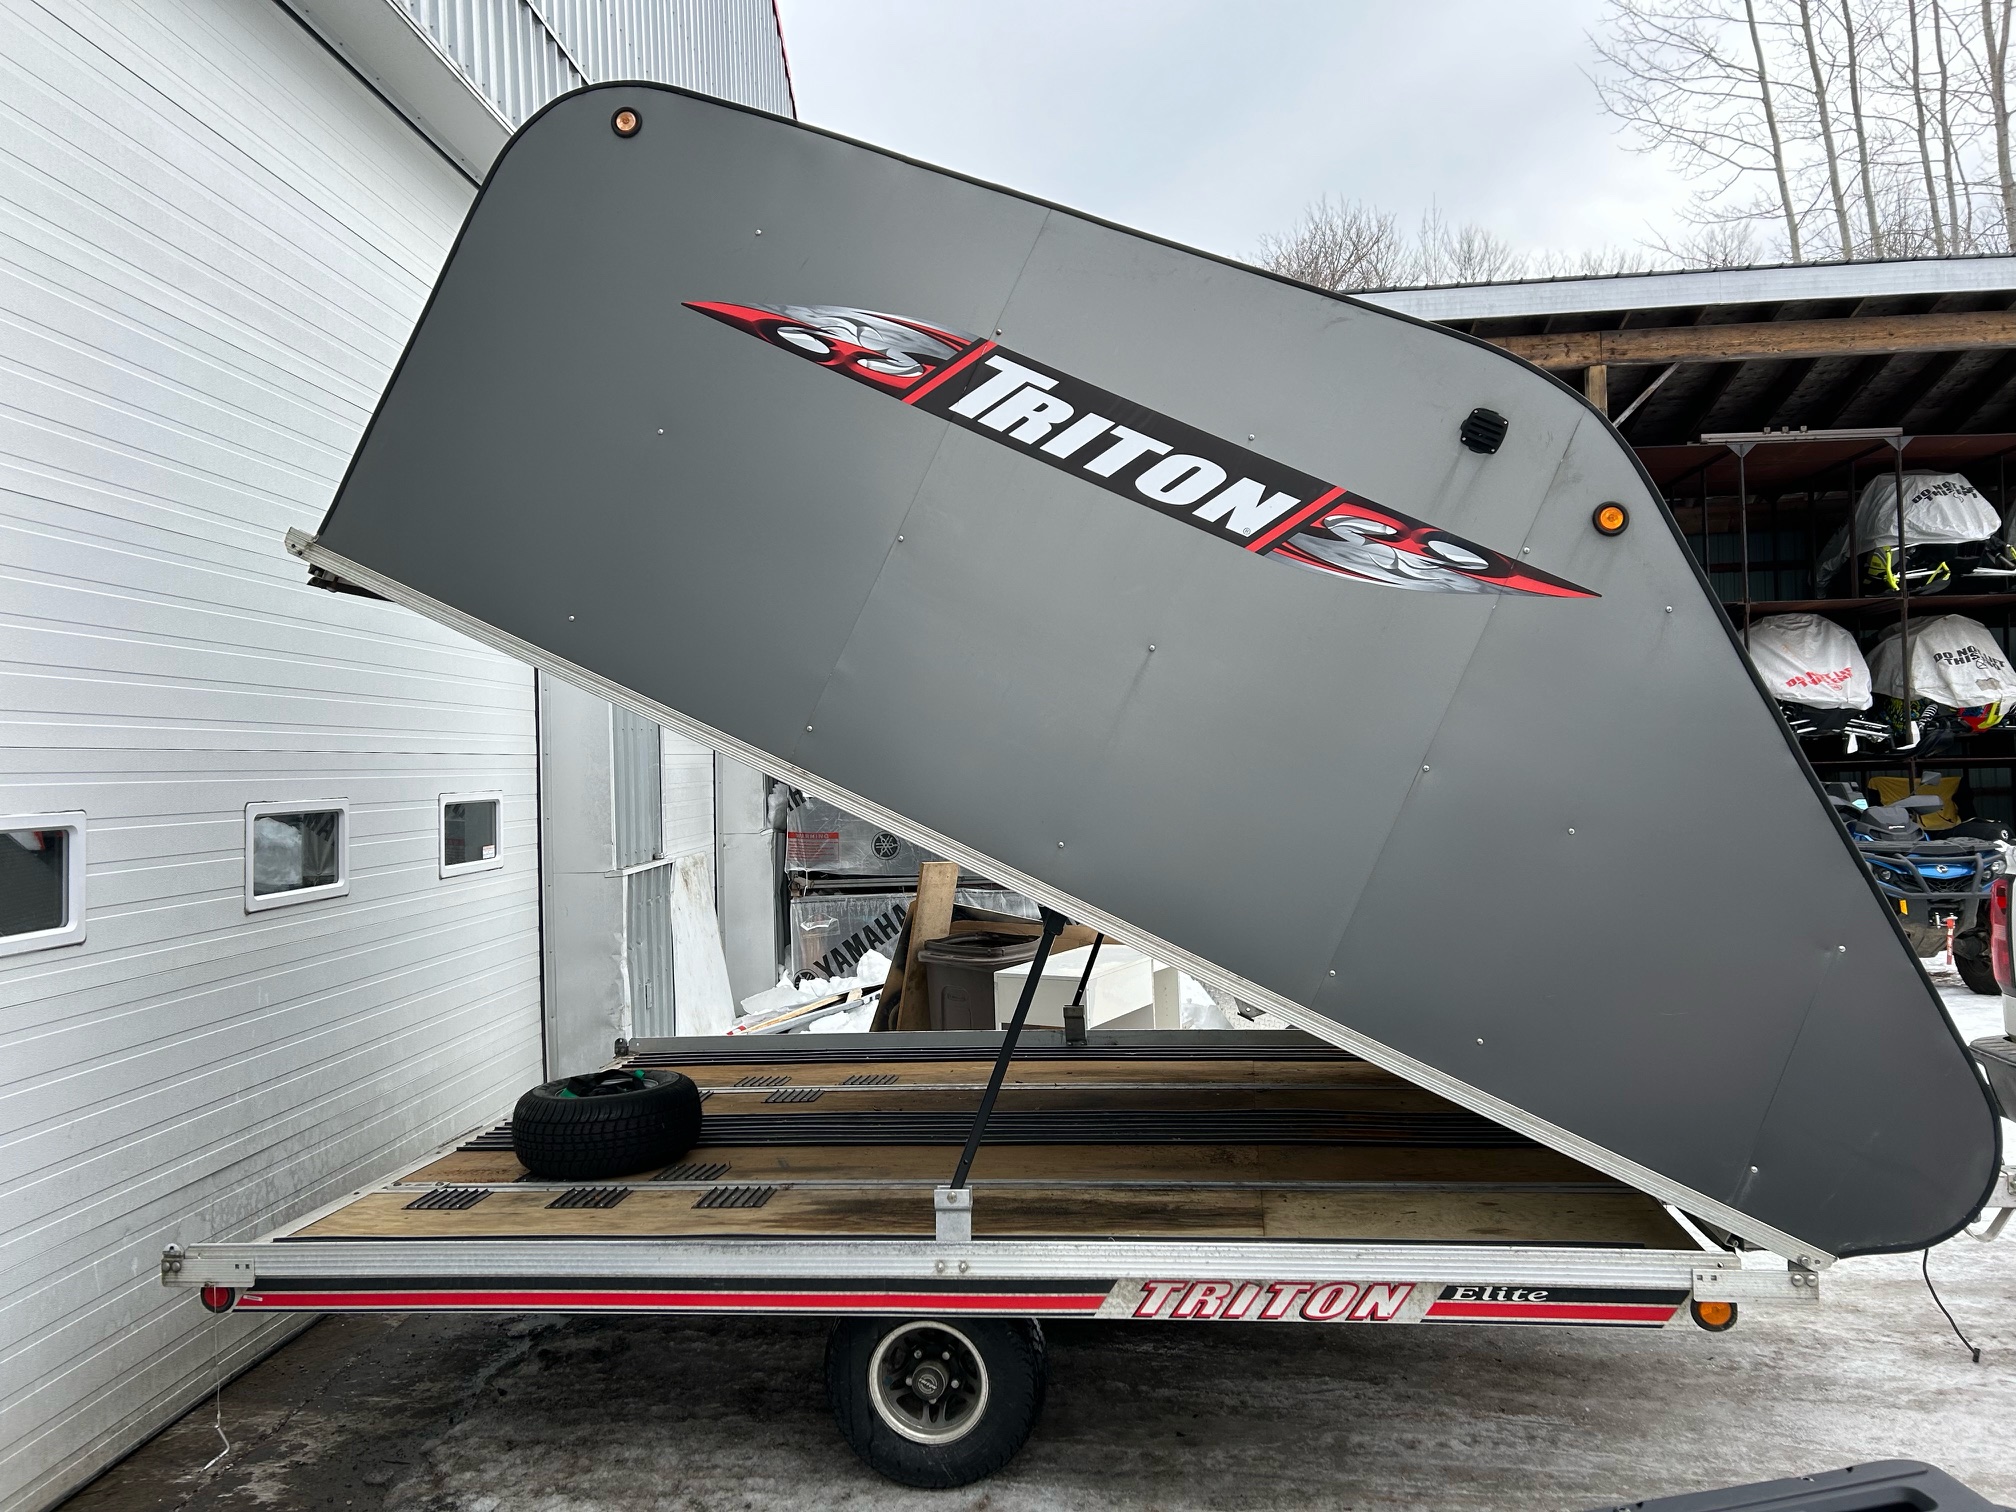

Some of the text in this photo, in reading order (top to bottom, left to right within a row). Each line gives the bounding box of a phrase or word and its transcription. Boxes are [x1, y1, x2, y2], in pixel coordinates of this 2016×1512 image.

[948, 354, 1302, 537] TRITON
[1933, 651, 1954, 663] DO
[1943, 652, 1980, 665] THIS
[813, 904, 906, 983] YAMAHA
[1132, 1281, 1549, 1321] TRITON Elite
